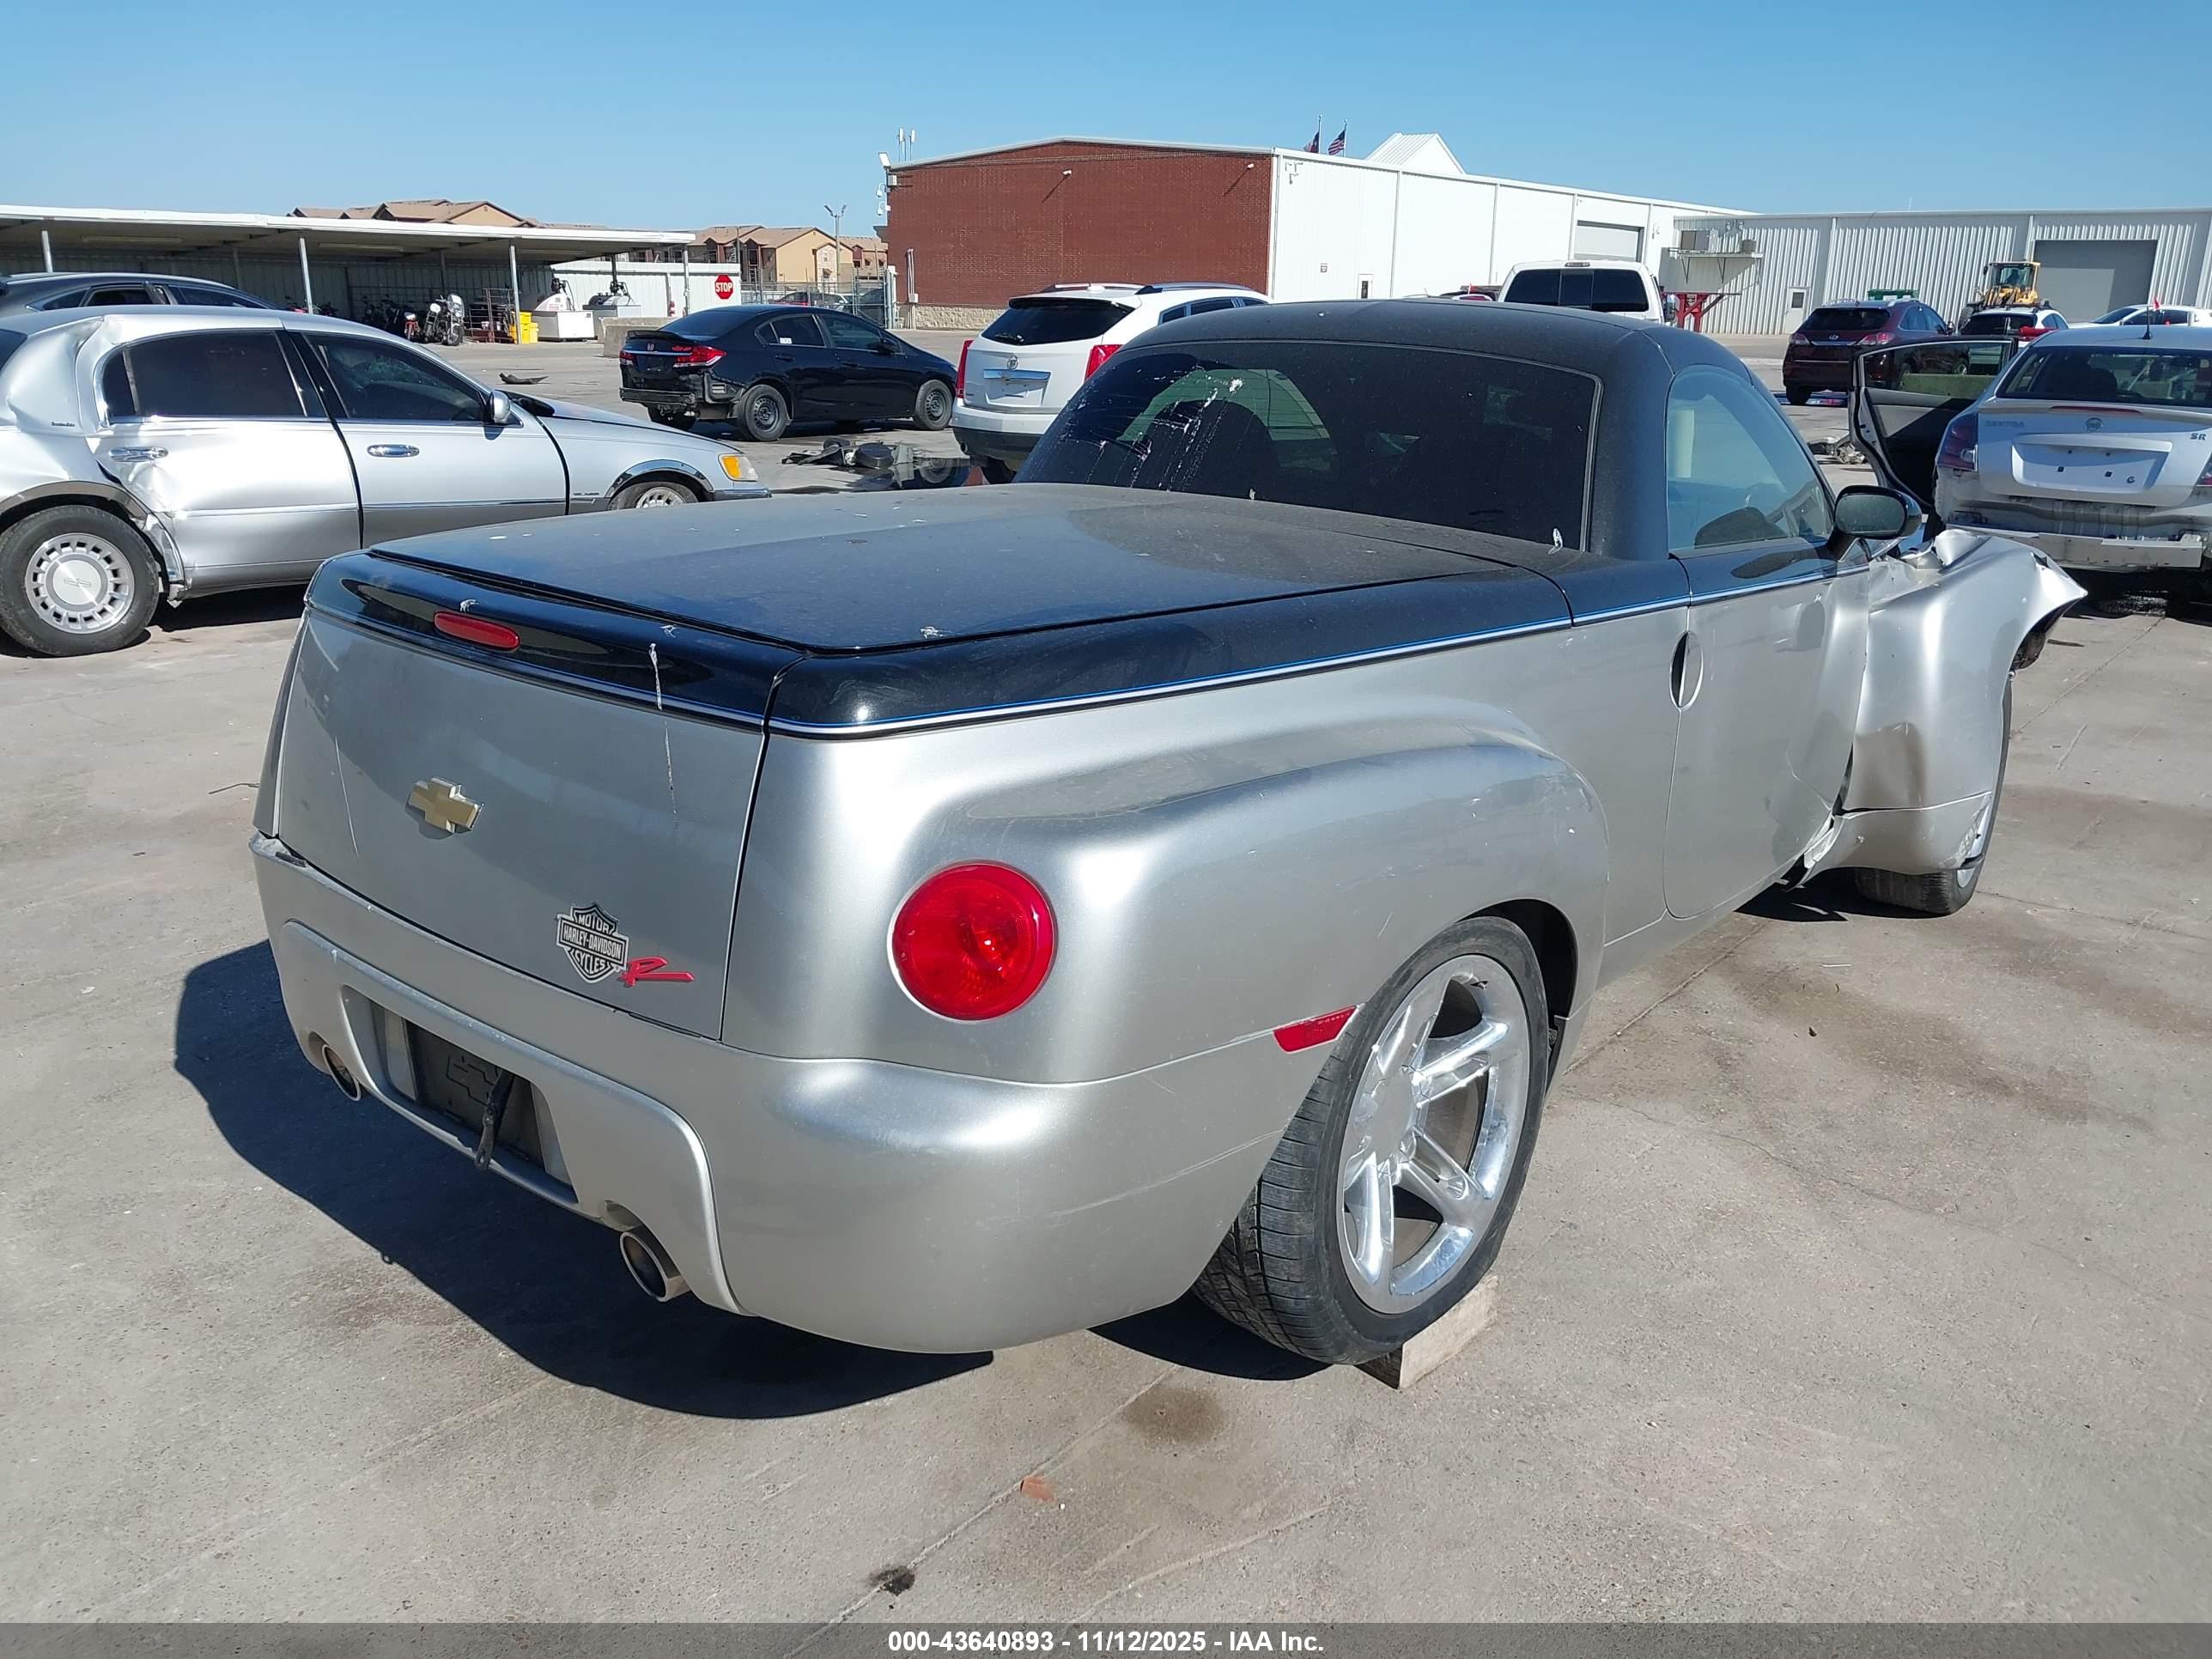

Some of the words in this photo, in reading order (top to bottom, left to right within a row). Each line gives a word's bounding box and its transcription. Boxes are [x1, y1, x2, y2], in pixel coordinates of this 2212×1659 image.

[715, 282, 732, 293] STOP
[2190, 432, 2207, 441] SR
[578, 913, 611, 934] MOTOR
[562, 925, 623, 960] HARLEY-DAVIDSON
[574, 950, 605, 975] CYCLES
